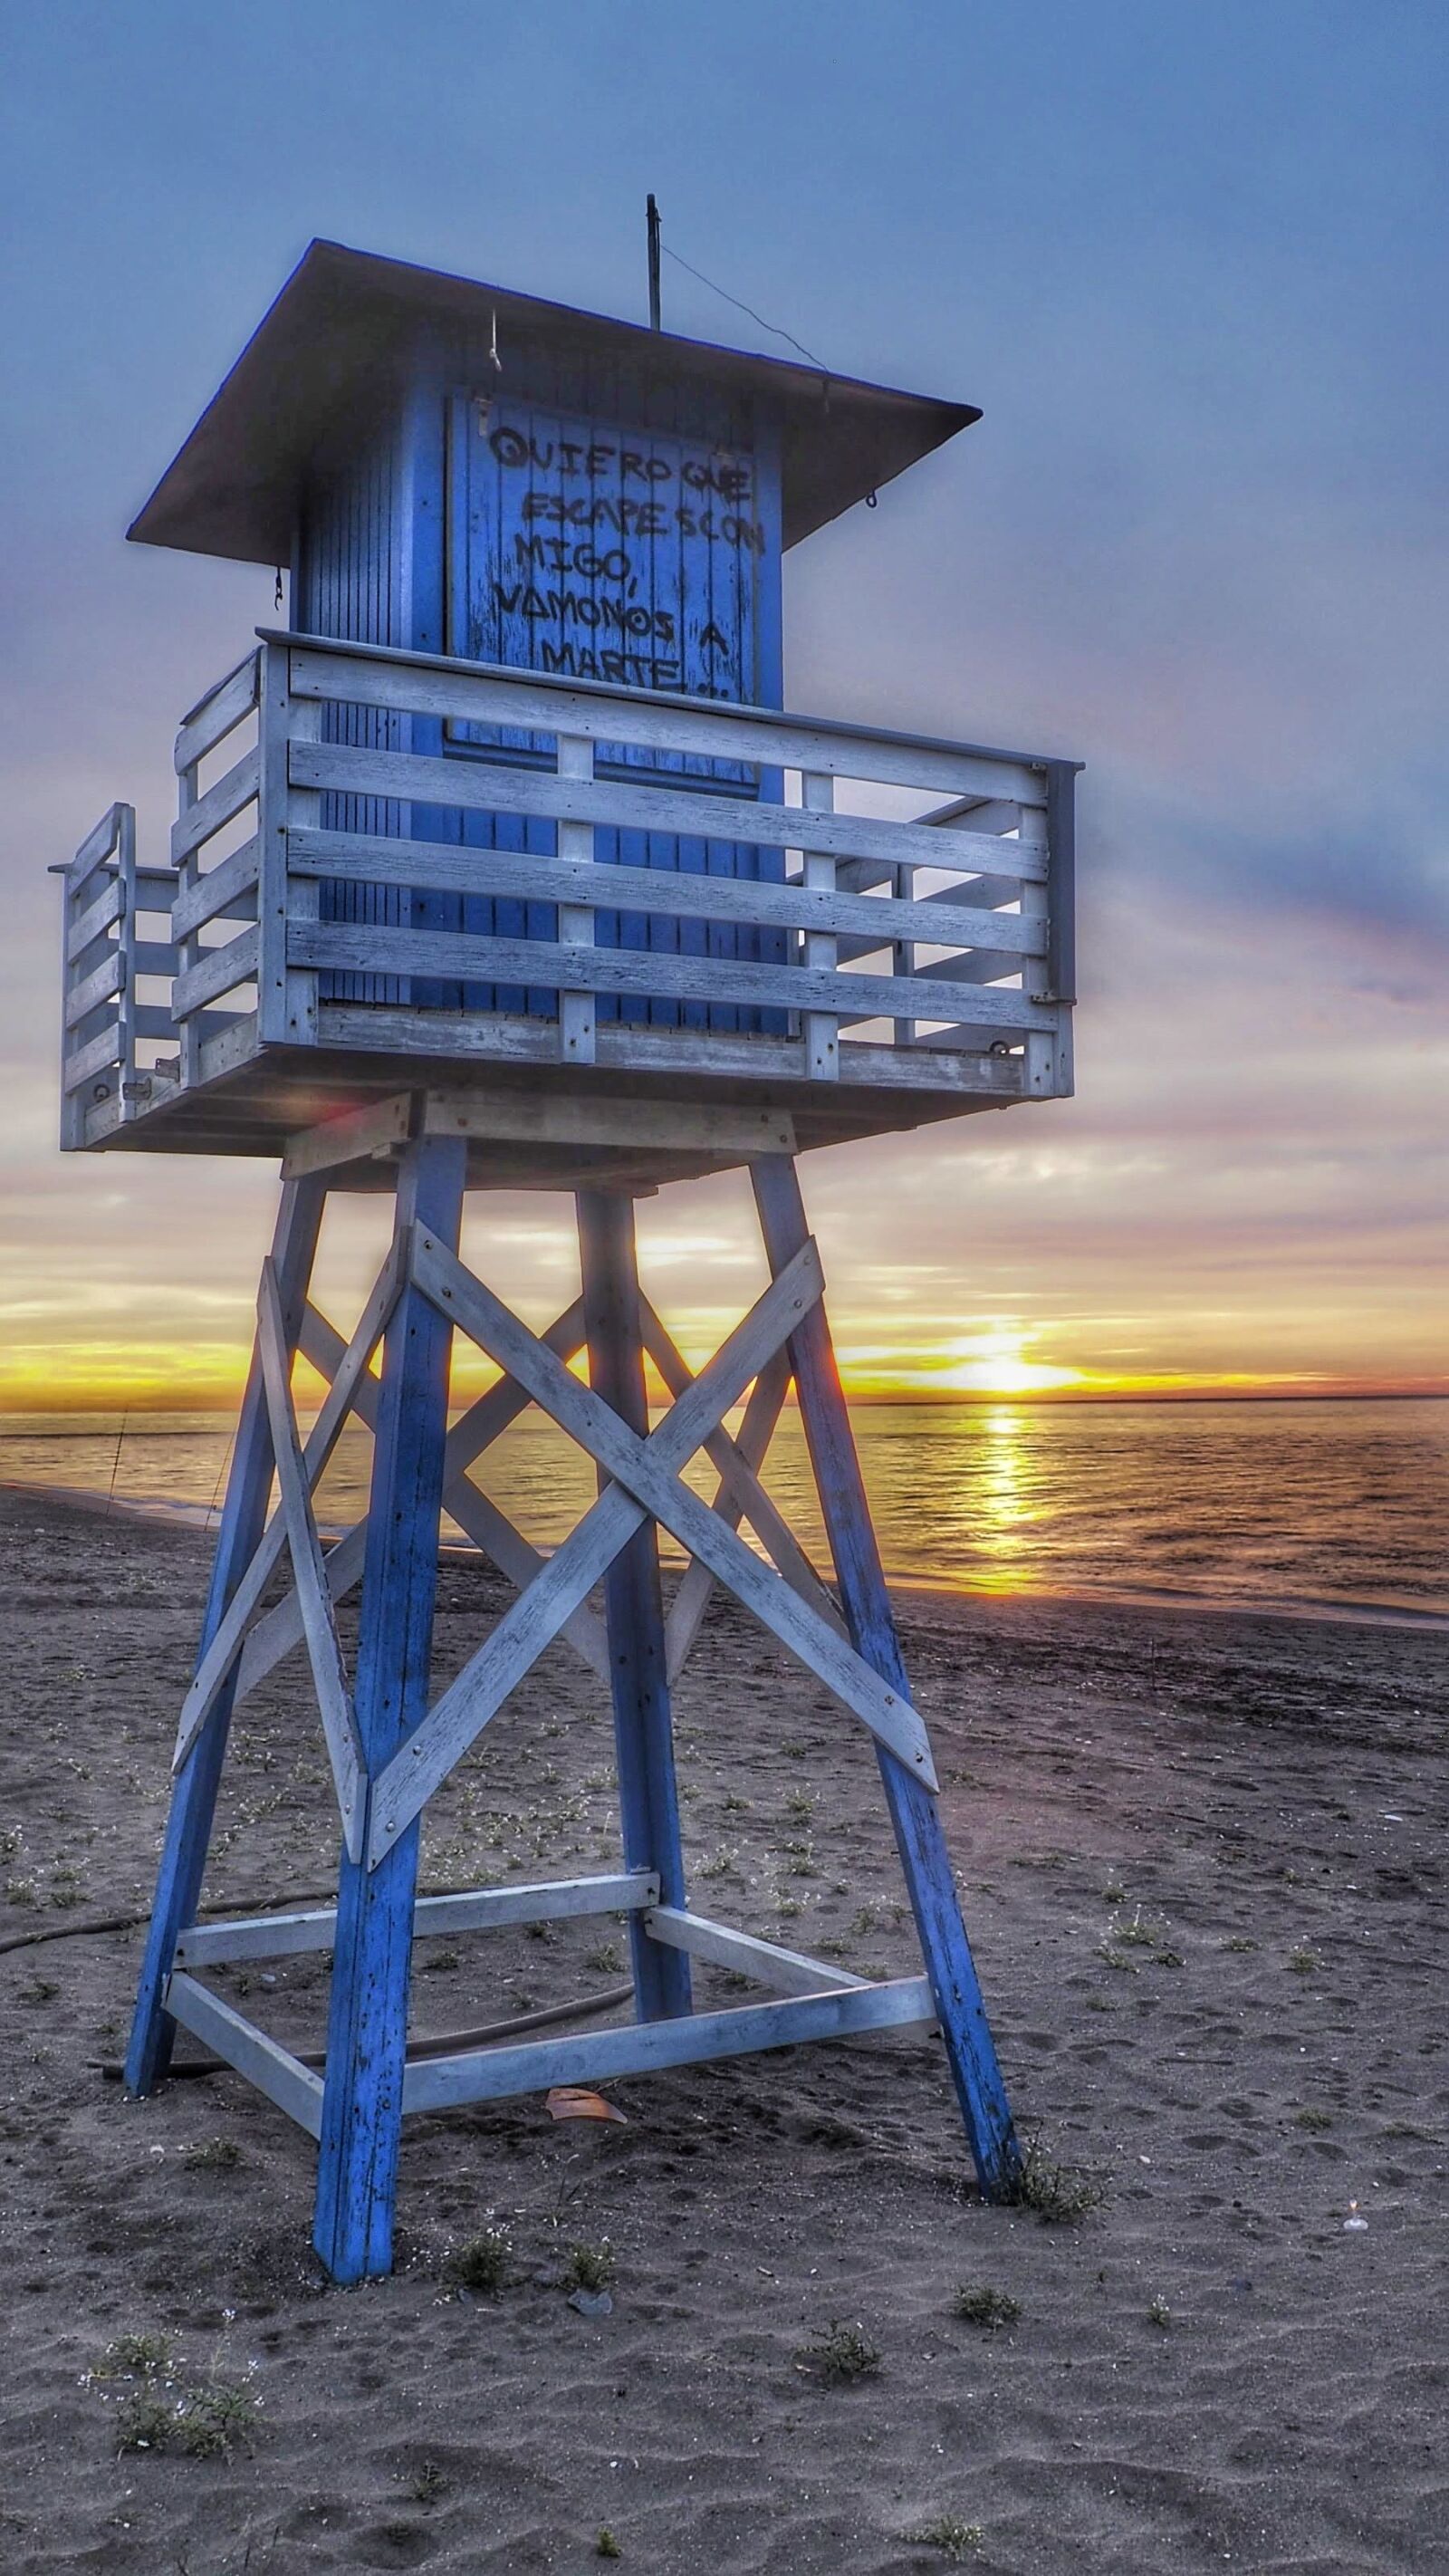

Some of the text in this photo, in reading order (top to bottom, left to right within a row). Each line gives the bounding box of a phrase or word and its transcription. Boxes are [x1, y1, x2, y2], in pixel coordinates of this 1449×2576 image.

[489, 427, 750, 502] QUIERO QUE
[493, 582, 729, 657] VAMONOS A
